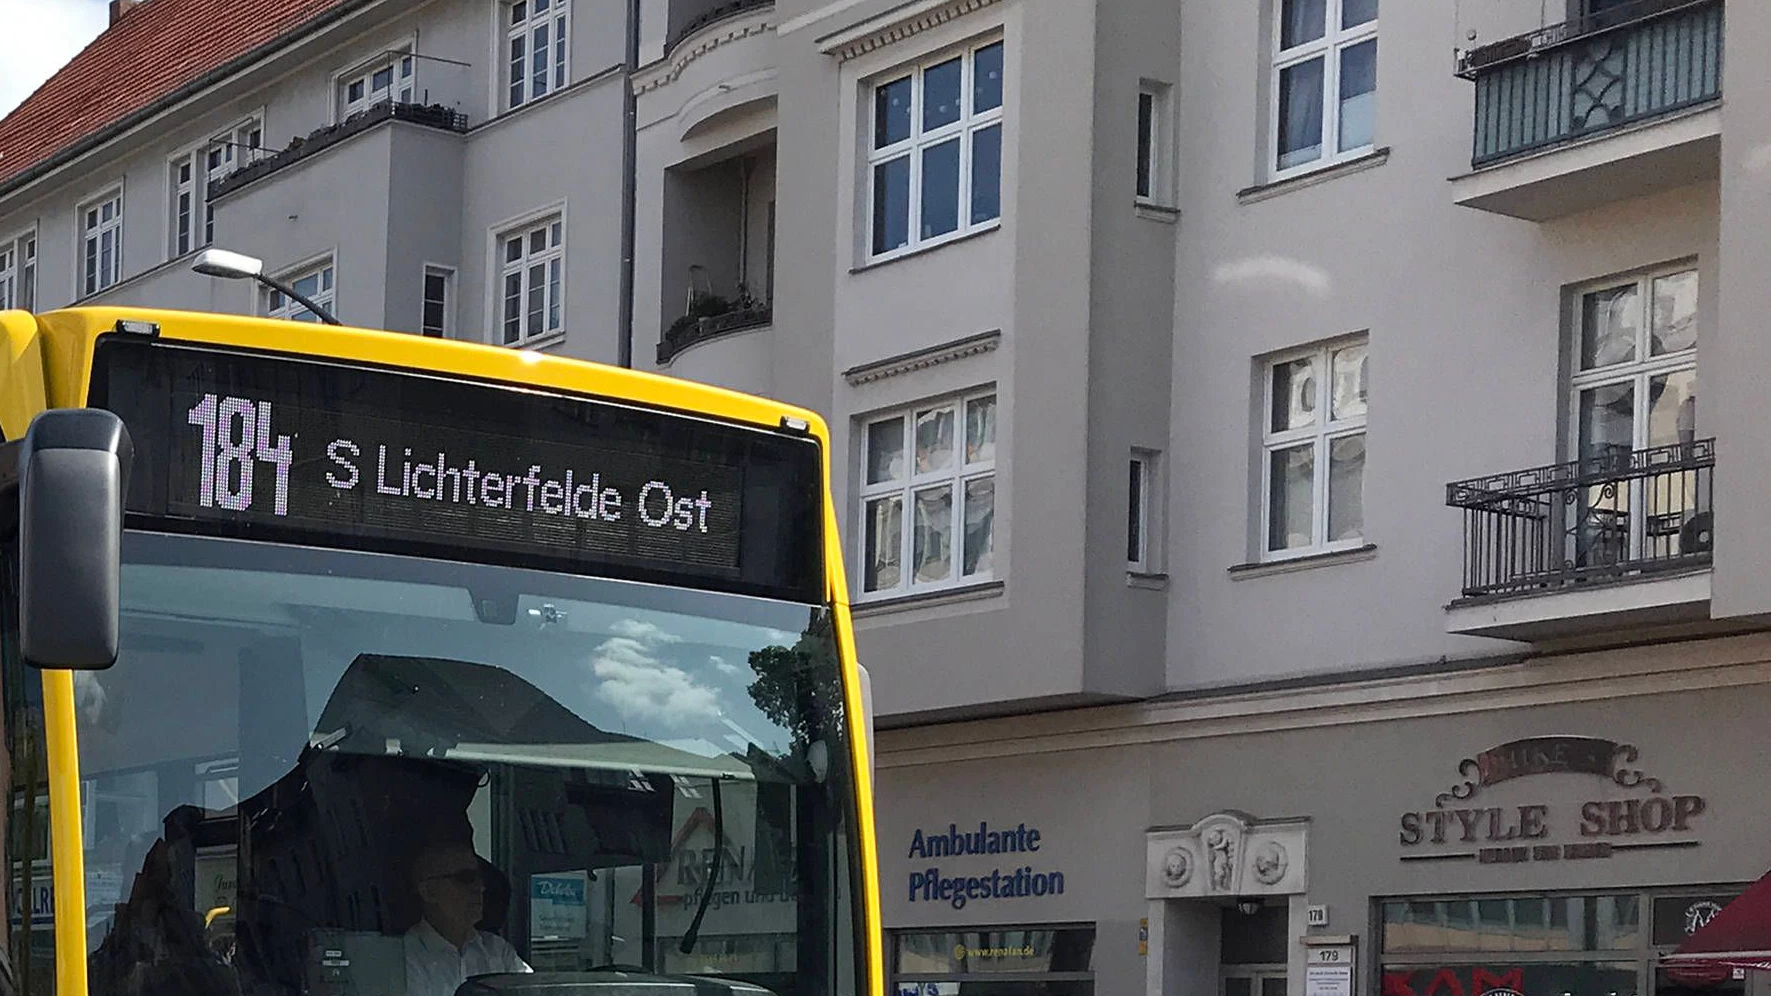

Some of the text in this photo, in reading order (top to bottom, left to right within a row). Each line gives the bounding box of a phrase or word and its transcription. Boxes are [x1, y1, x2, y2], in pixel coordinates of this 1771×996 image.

[187, 392, 713, 533] 184 S Lichterfelde Ost
[908, 822, 1041, 859] Ambulante
[1400, 795, 1706, 847] STYLE SHOP
[908, 866, 1064, 910] Pflegestation
[1308, 909, 1323, 922] 179
[1319, 951, 1339, 962] 179
